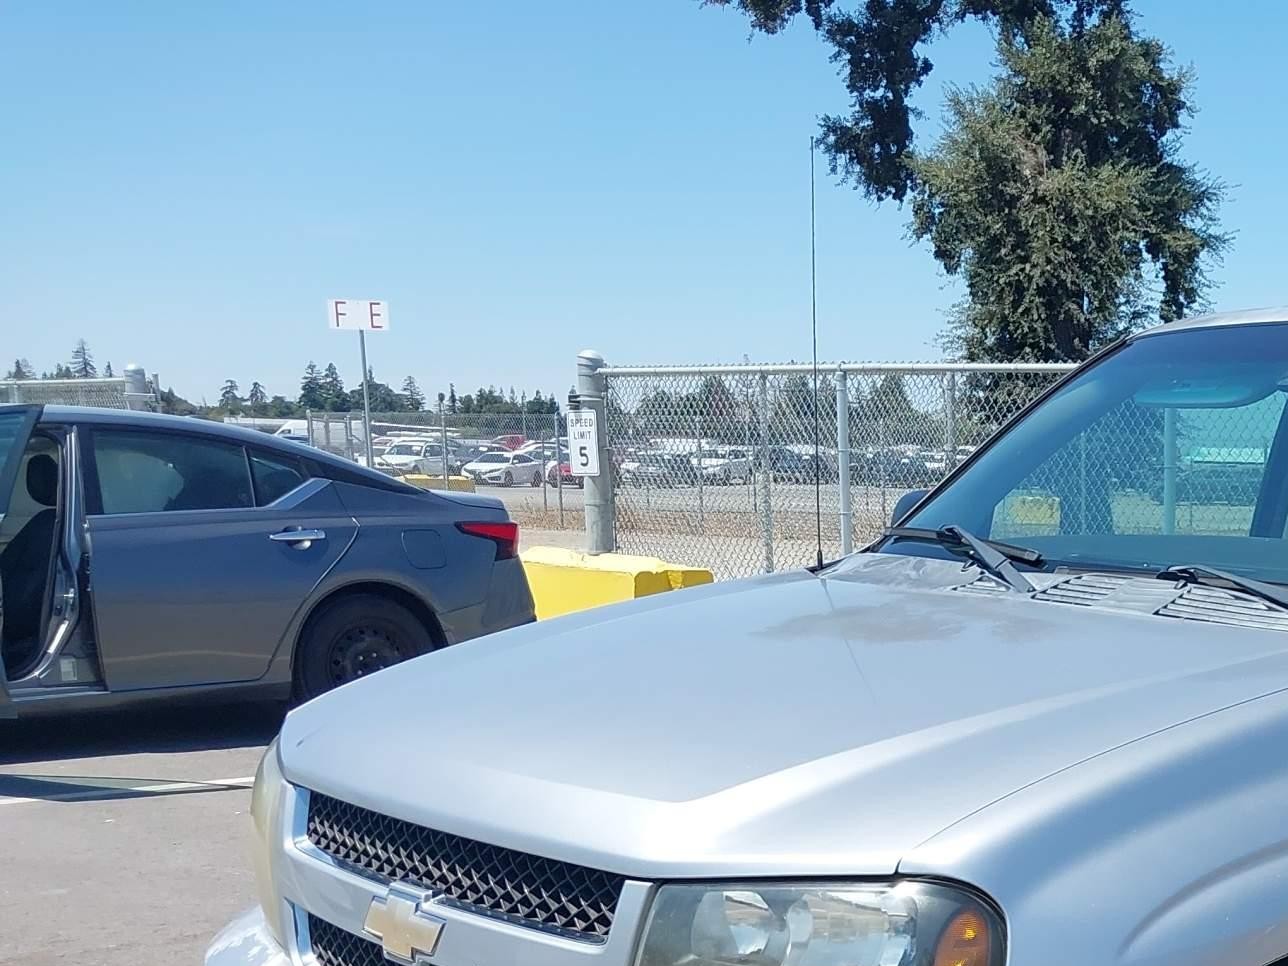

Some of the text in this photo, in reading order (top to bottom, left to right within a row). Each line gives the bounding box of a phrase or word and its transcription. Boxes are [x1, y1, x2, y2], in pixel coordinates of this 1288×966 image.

[334, 300, 384, 329] F E
[570, 418, 593, 428] SPEED
[573, 430, 592, 441] LIMIT
[579, 445, 589, 467] 5
